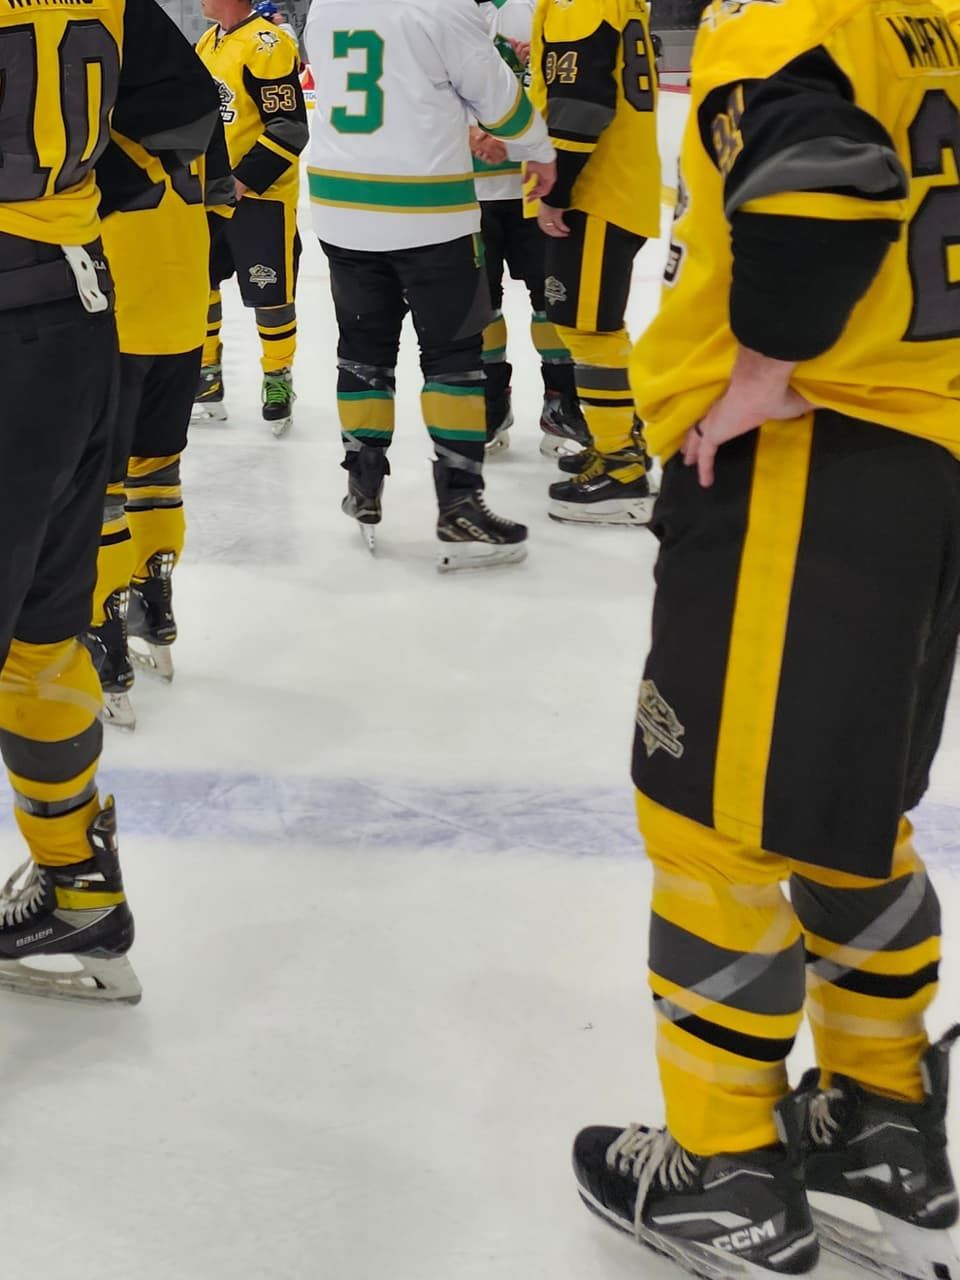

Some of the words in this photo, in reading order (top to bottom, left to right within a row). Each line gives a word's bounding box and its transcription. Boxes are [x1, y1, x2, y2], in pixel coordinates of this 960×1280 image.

[329, 29, 385, 135] 3
[261, 84, 297, 114] 53
[712, 1220, 777, 1251] CCM
